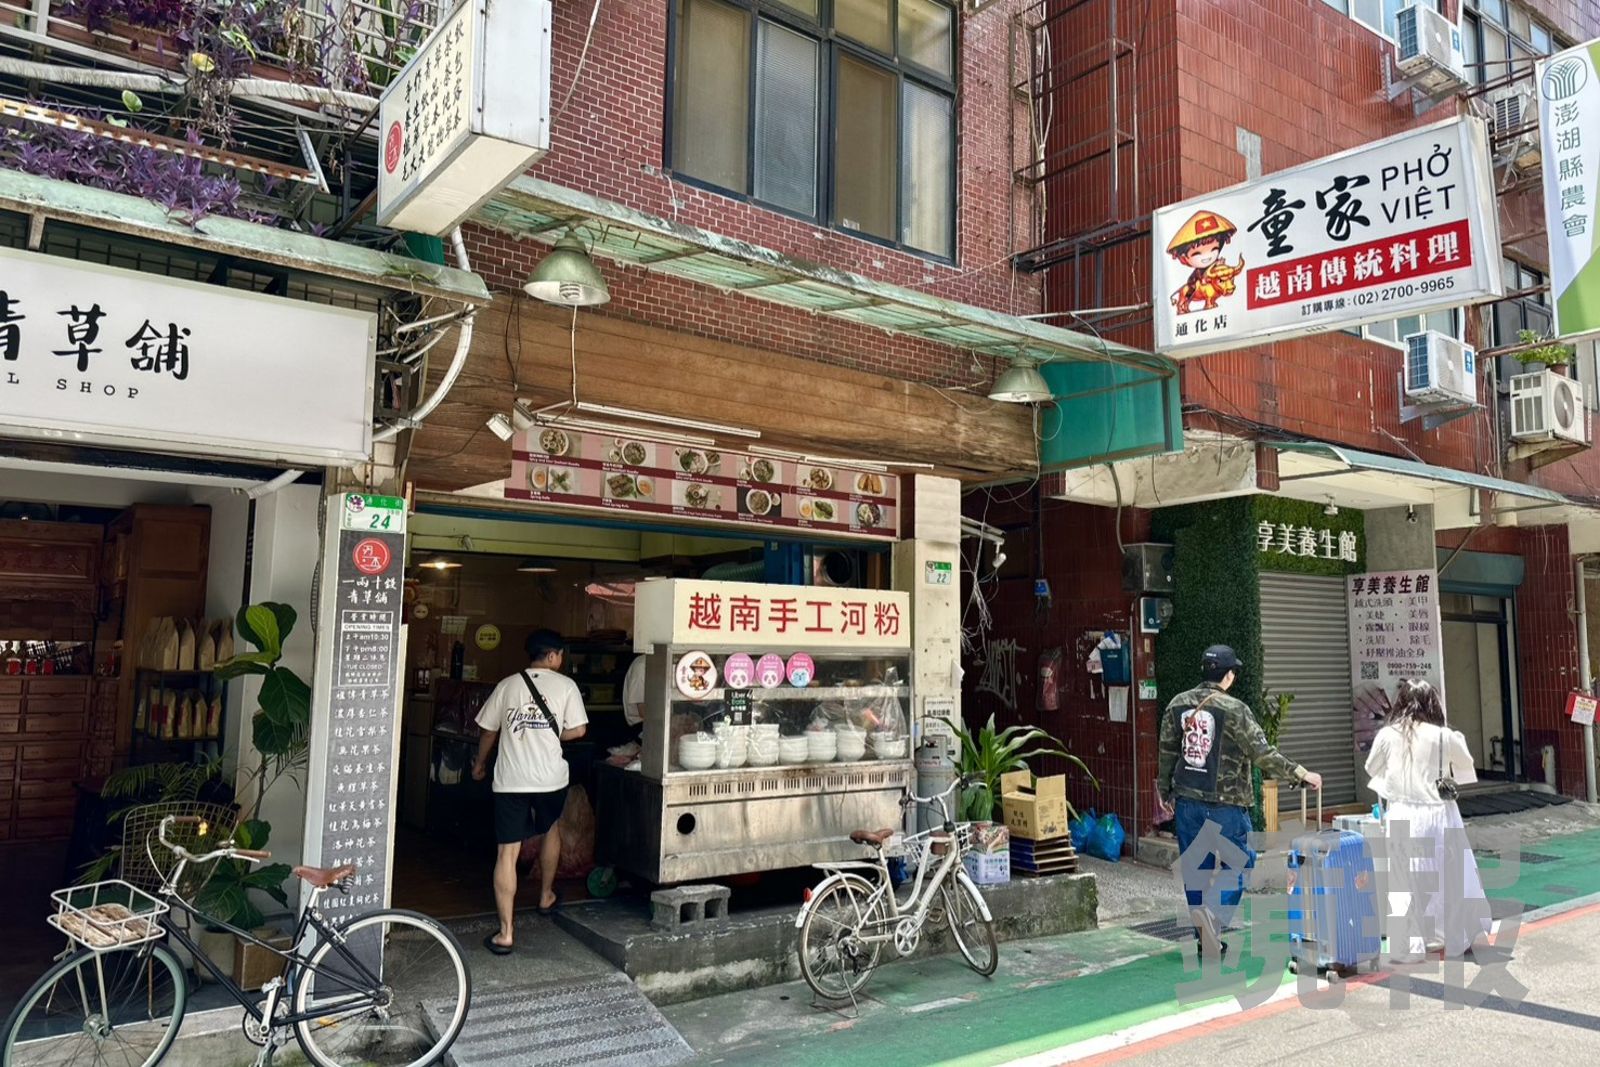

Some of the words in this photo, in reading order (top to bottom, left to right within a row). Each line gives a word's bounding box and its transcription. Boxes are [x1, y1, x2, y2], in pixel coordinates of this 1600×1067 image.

[1381, 143, 1452, 192] PHỞ
[1555, 102, 1588, 237] 澎湖縣農會
[1246, 175, 1371, 258] 童家
[1381, 184, 1456, 224] VIỆT
[1253, 230, 1460, 301] 越南傳統料理
[1175, 314, 1228, 337] 通化店
[56, 378, 139, 399] SHOP
[369, 514, 391, 529] 24
[1257, 520, 1357, 563] 享美養生館
[936, 573, 947, 583] 22
[1352, 574, 1430, 595] 享美養生館
[688, 592, 901, 637] 越南手工河粉
